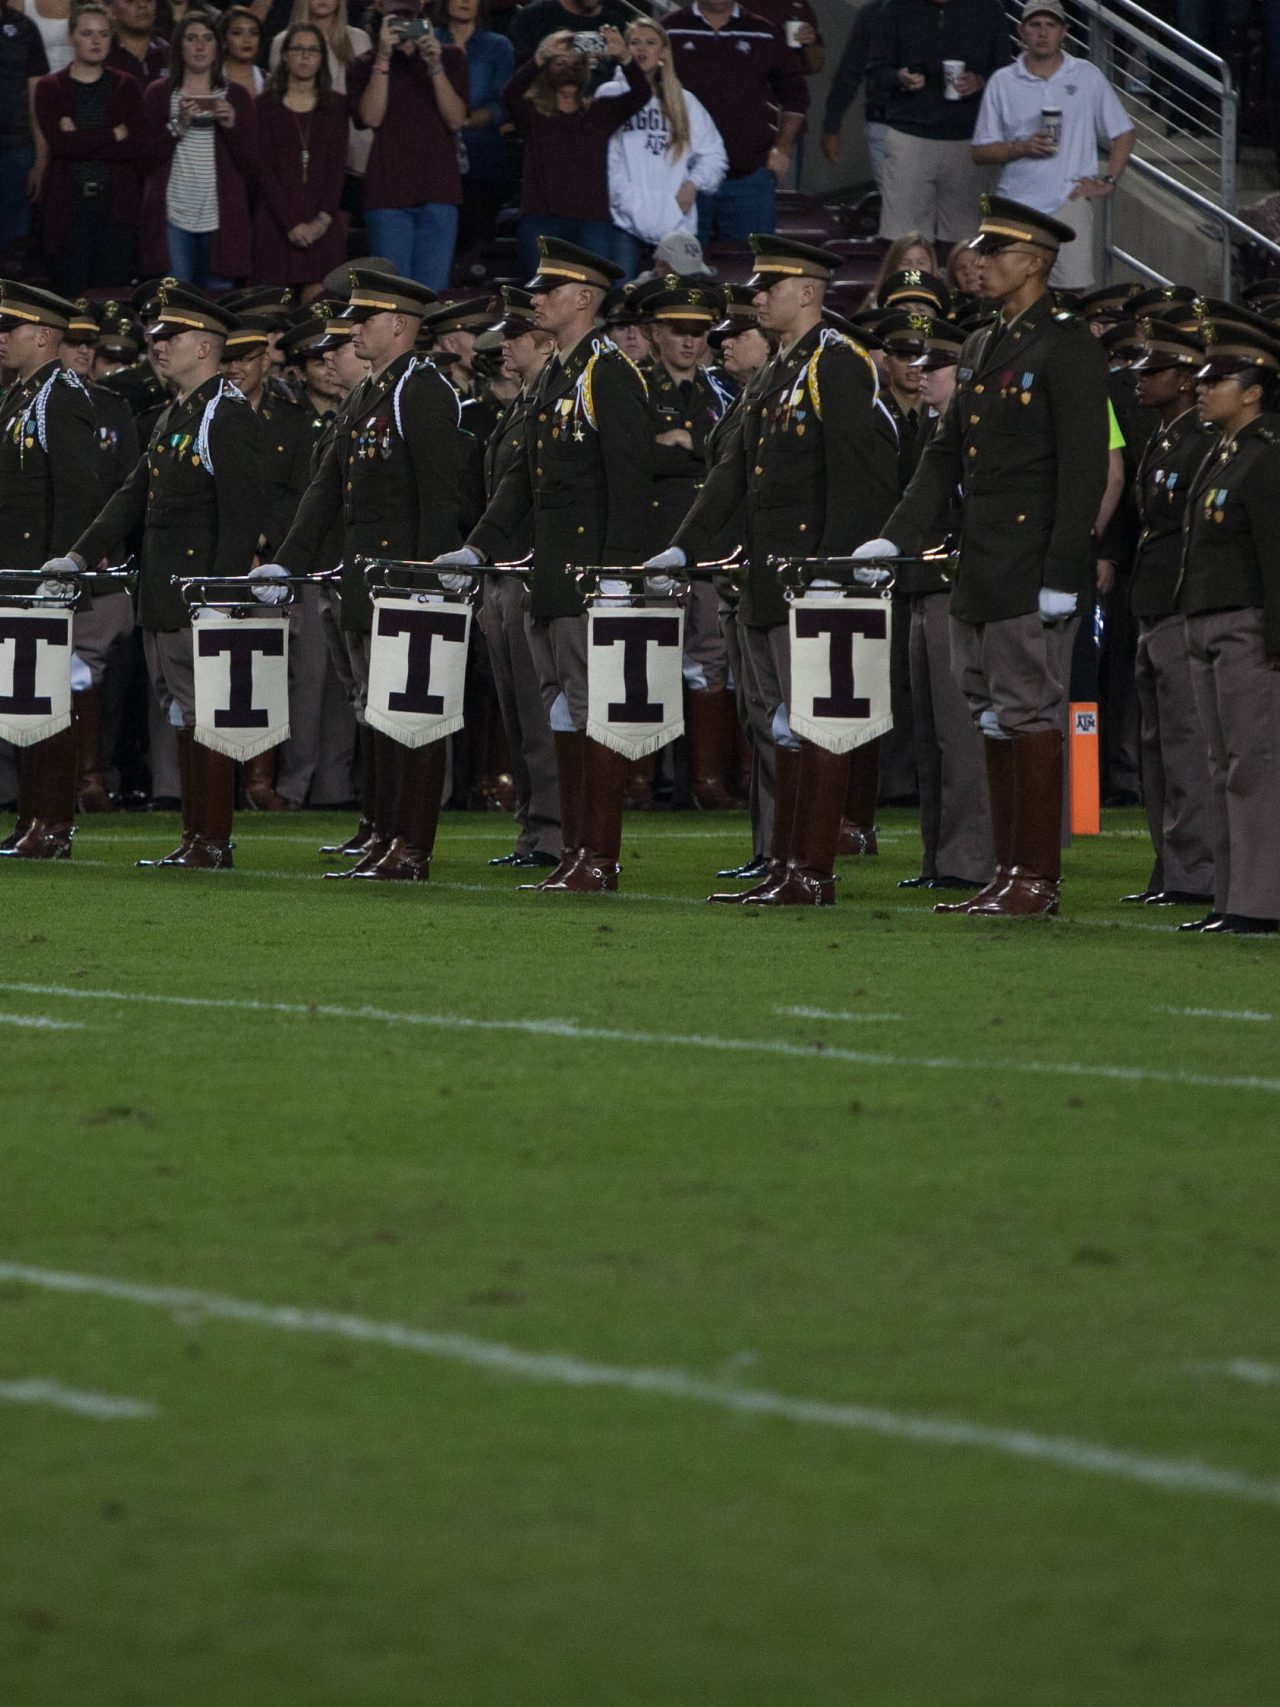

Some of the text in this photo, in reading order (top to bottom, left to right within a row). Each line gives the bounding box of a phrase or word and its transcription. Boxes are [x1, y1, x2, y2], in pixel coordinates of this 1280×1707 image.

[621, 107, 671, 132] AGGI
[198, 629, 284, 728] T
[378, 608, 467, 715] T
[593, 617, 680, 723] T
[796, 608, 887, 719] T
